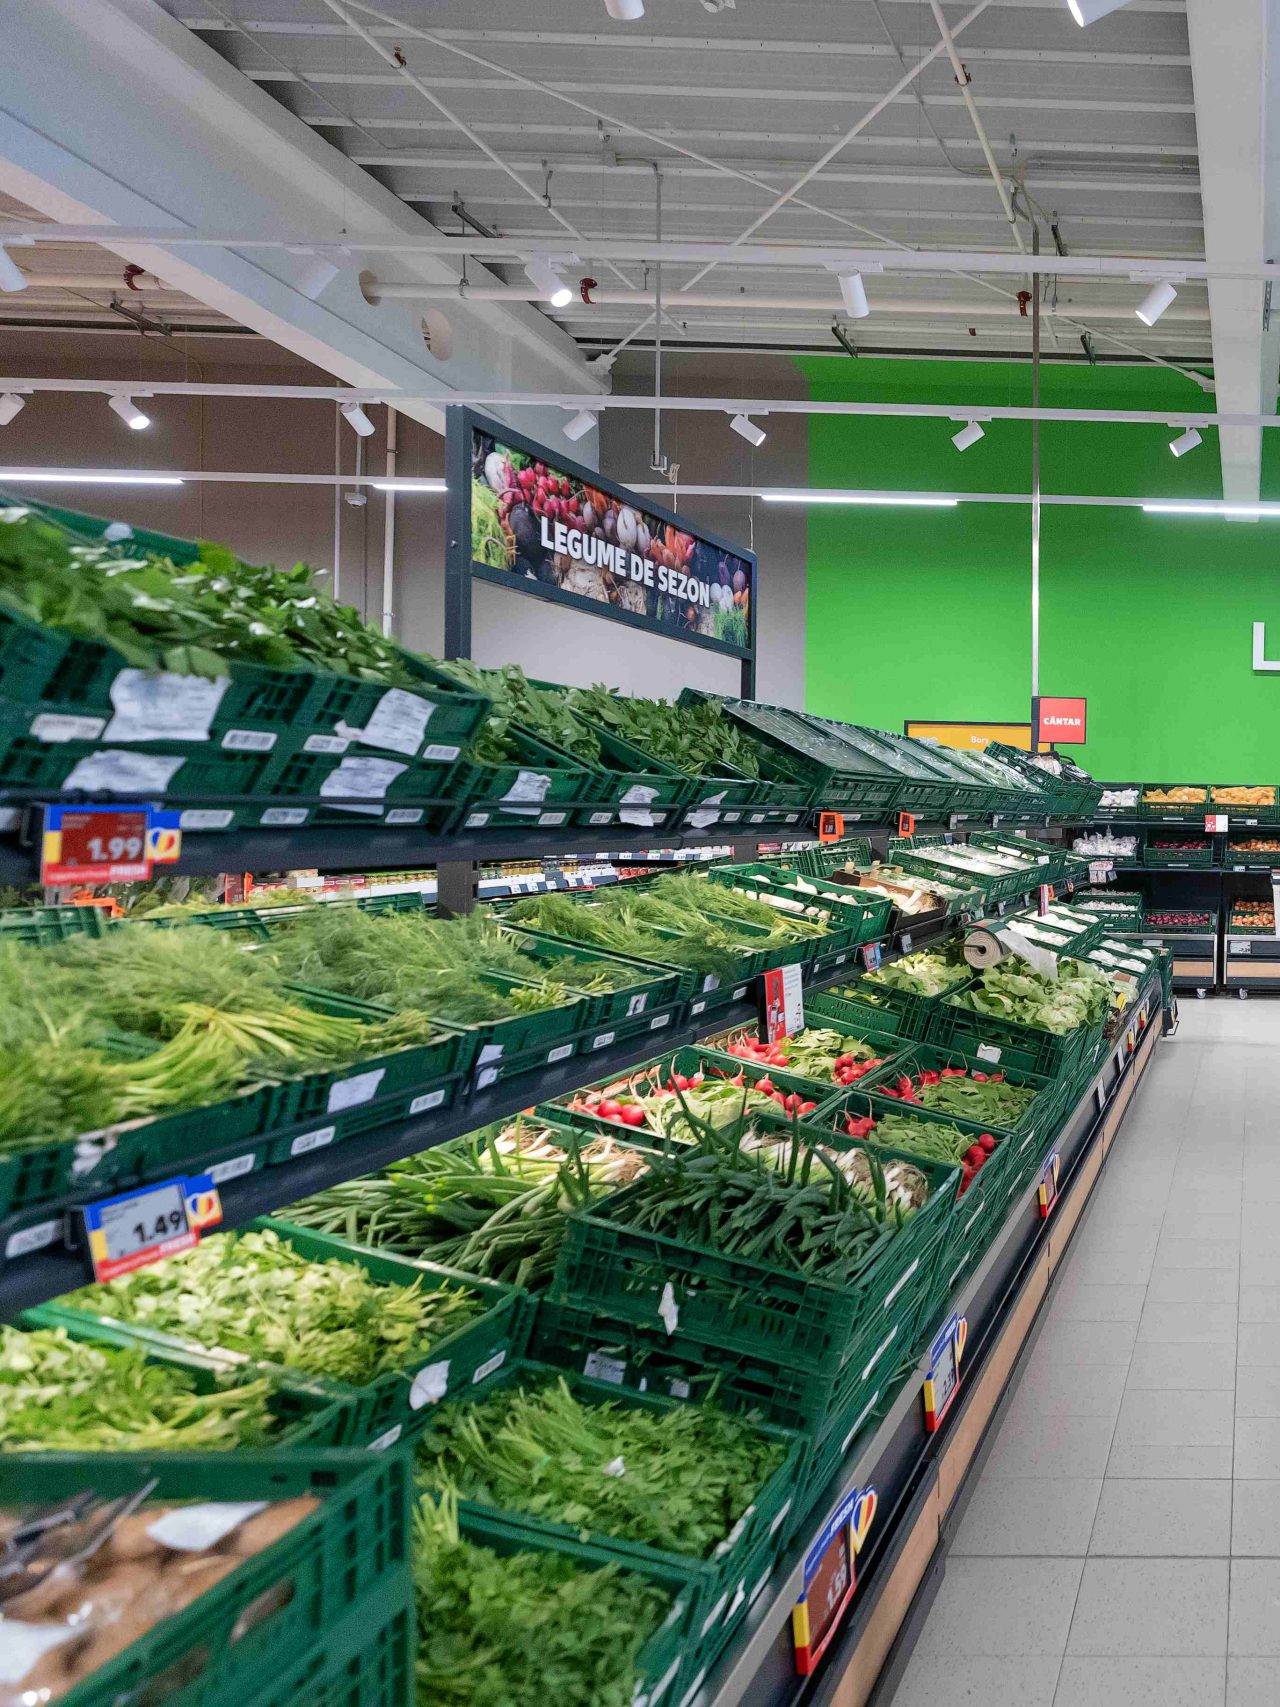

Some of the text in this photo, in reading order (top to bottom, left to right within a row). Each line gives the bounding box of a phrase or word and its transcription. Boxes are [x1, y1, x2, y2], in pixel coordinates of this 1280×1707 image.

[540, 515, 710, 608] LEGUME DE SEZON
[1043, 715, 1081, 726] CÂNTAR
[86, 836, 143, 861] 1.99
[133, 1210, 182, 1243] 1.49
